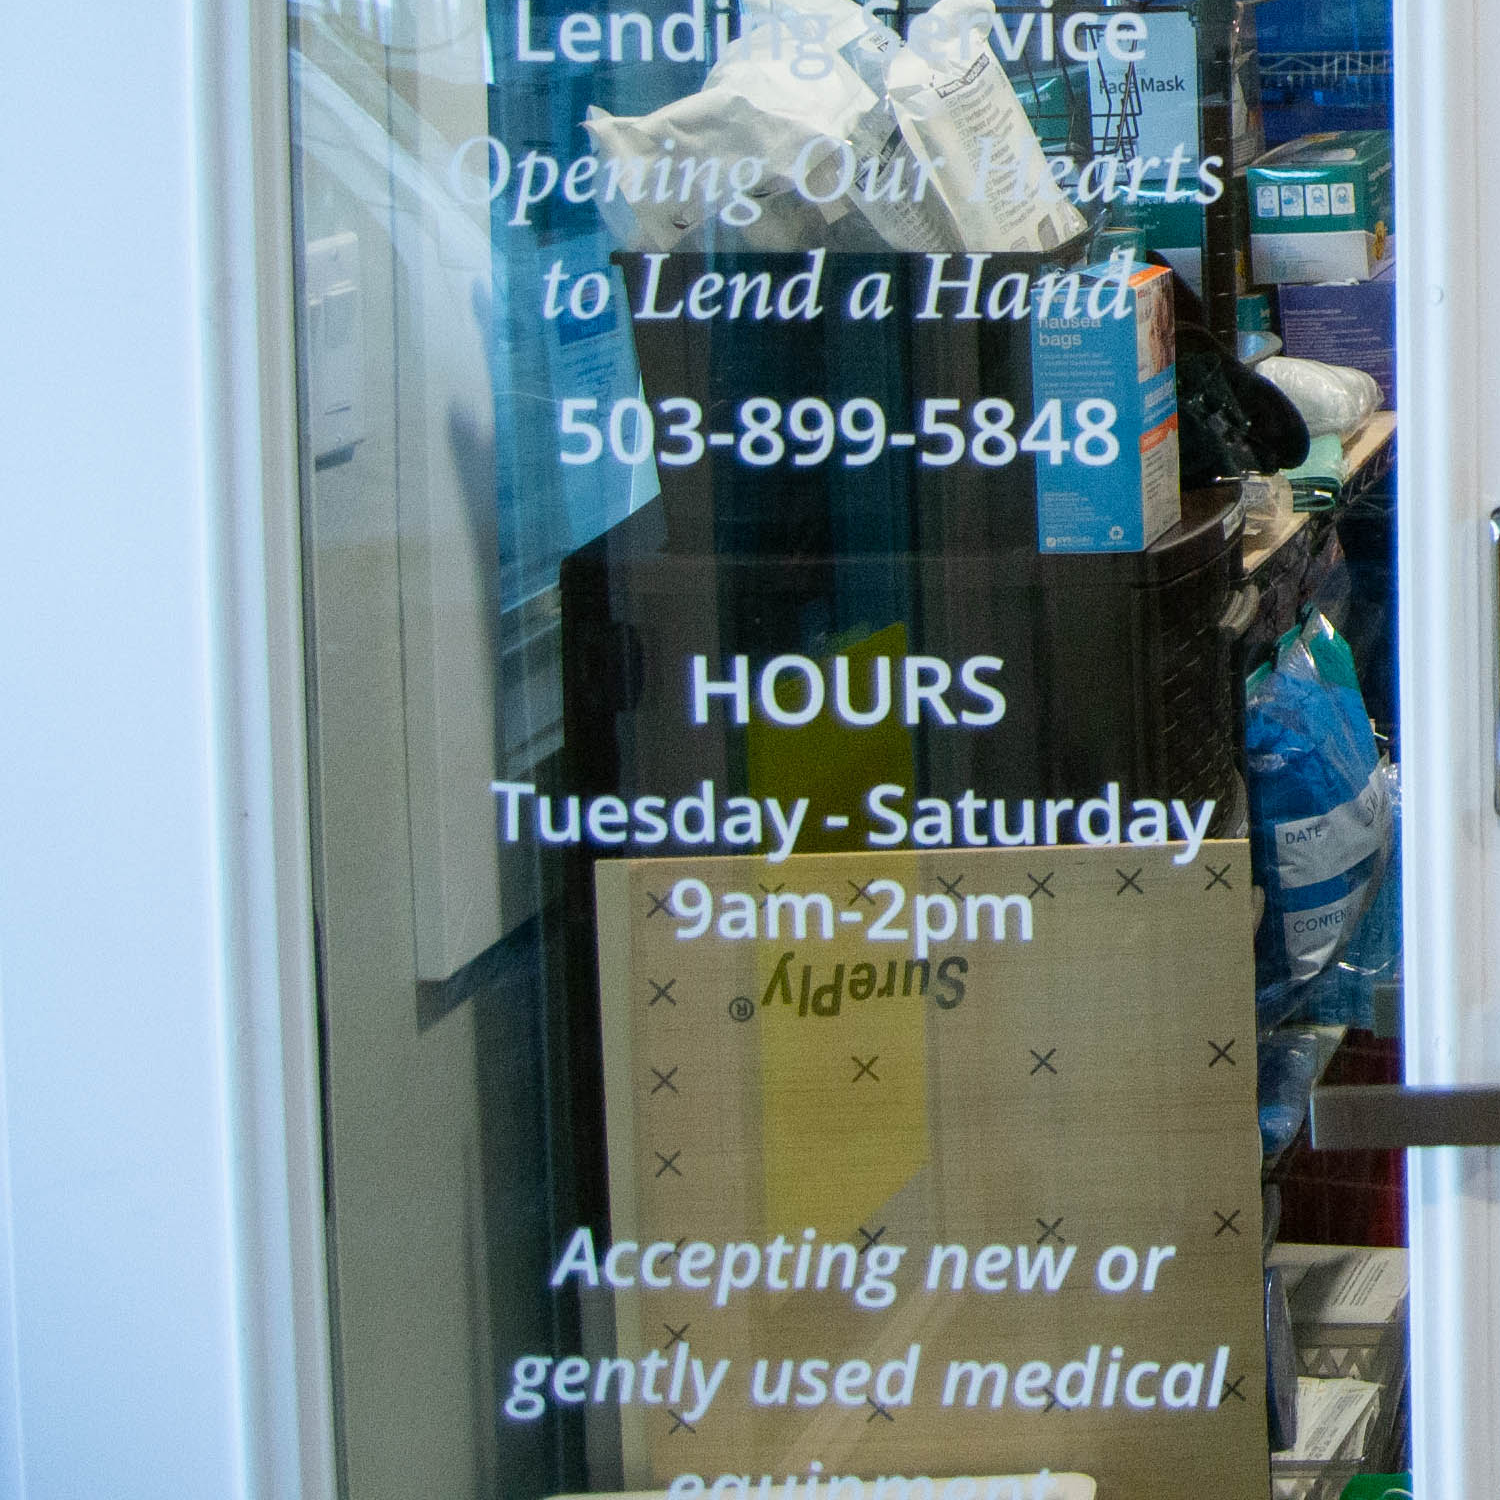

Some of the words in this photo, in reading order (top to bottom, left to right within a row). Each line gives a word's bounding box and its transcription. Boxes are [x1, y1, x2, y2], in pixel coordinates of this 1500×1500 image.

[1141, 75, 1185, 93] Mask
[450, 134, 764, 226] Opening
[794, 137, 944, 204] Our
[968, 132, 1225, 206] Hearts
[543, 260, 607, 321] to
[635, 248, 823, 322] Lend
[848, 274, 892, 321] a
[915, 248, 1132, 322] Hand
[1039, 332, 1082, 349] bags
[559, 396, 1120, 468] 503-899-5848
[692, 653, 1006, 727] HOURS
[491, 779, 809, 863] Tuesday
[826, 815, 848, 828] -
[866, 781, 1215, 865] Saturday
[1285, 825, 1322, 845] DATE
[673, 877, 1034, 959] 9am-2pm
[549, 1226, 906, 1306] Accepting
[924, 1242, 1074, 1291] new
[1096, 1242, 1175, 1291] or
[504, 1341, 728, 1419] gently
[751, 1344, 922, 1407] used
[941, 1346, 1231, 1411] medical
